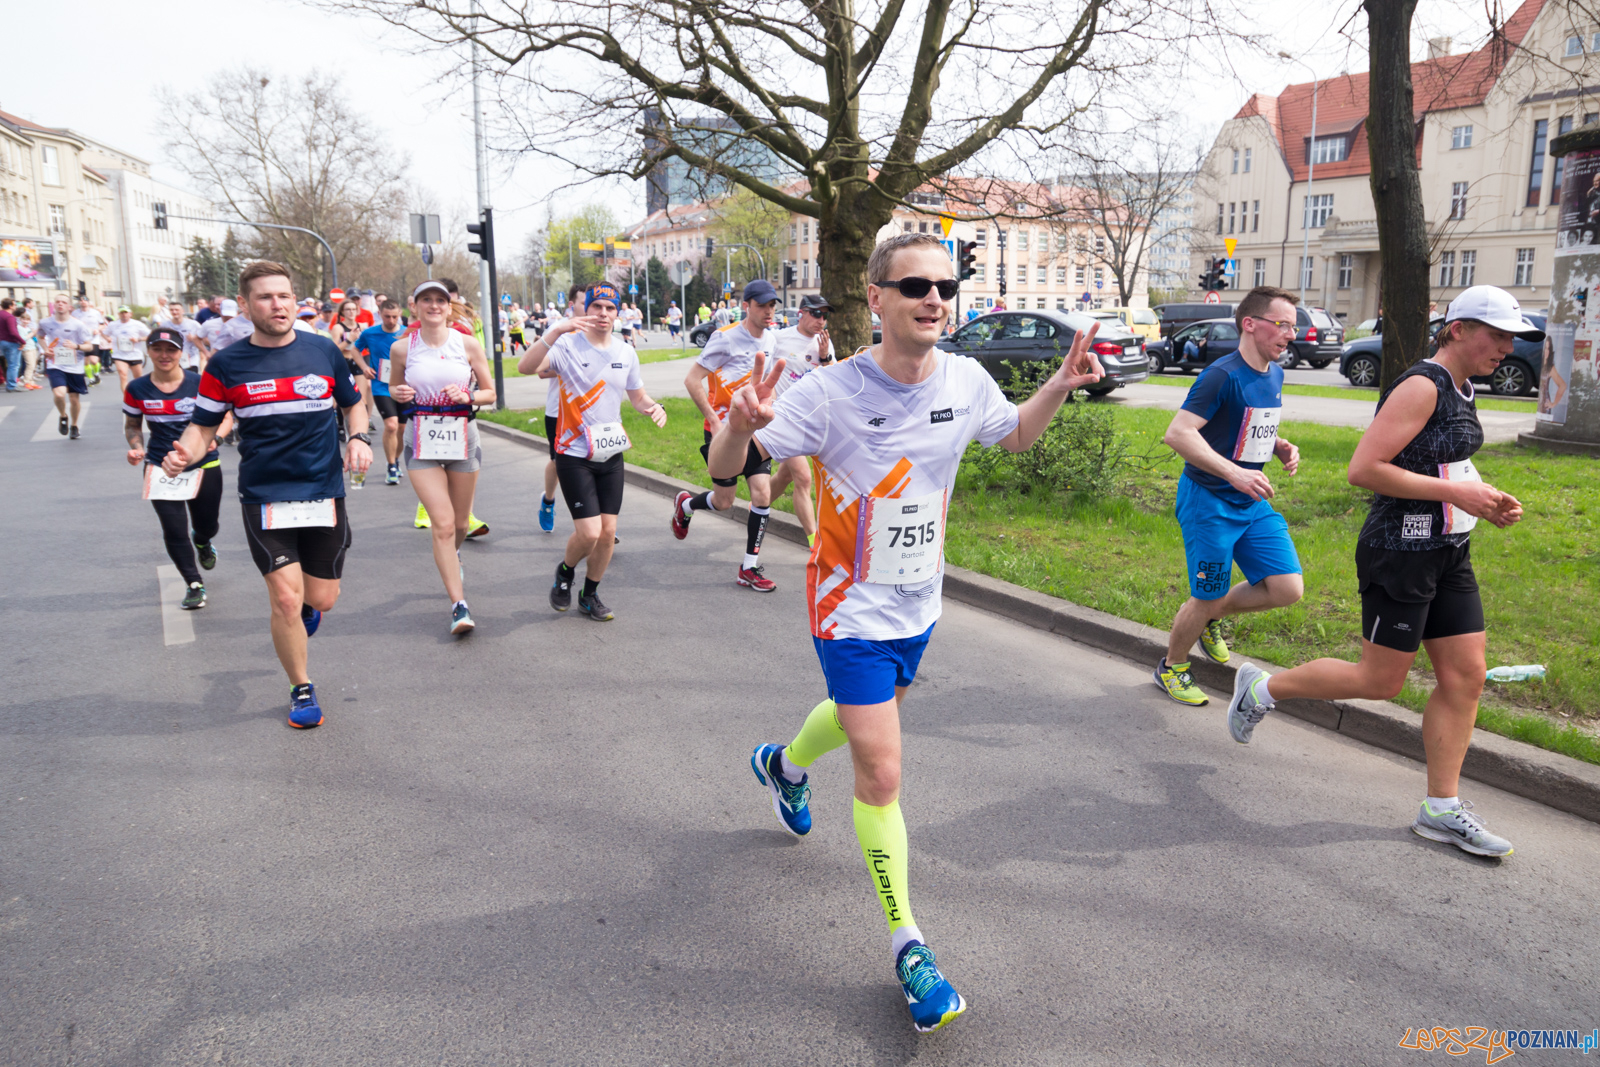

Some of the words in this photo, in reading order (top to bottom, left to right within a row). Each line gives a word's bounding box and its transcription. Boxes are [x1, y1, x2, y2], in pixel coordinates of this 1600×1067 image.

[868, 417, 886, 427] 4F
[428, 429, 457, 441] 9411
[595, 434, 627, 449] 10649
[159, 475, 189, 487] 6271
[1405, 521, 1430, 529] THE
[888, 520, 935, 548] 7515
[1404, 528, 1430, 536] LINE
[901, 550, 925, 560] Bartosz
[1198, 560, 1225, 573] GET
[1196, 581, 1222, 593] FOR
[1223, 578, 1230, 590] IT
[867, 848, 901, 922] kalenji
